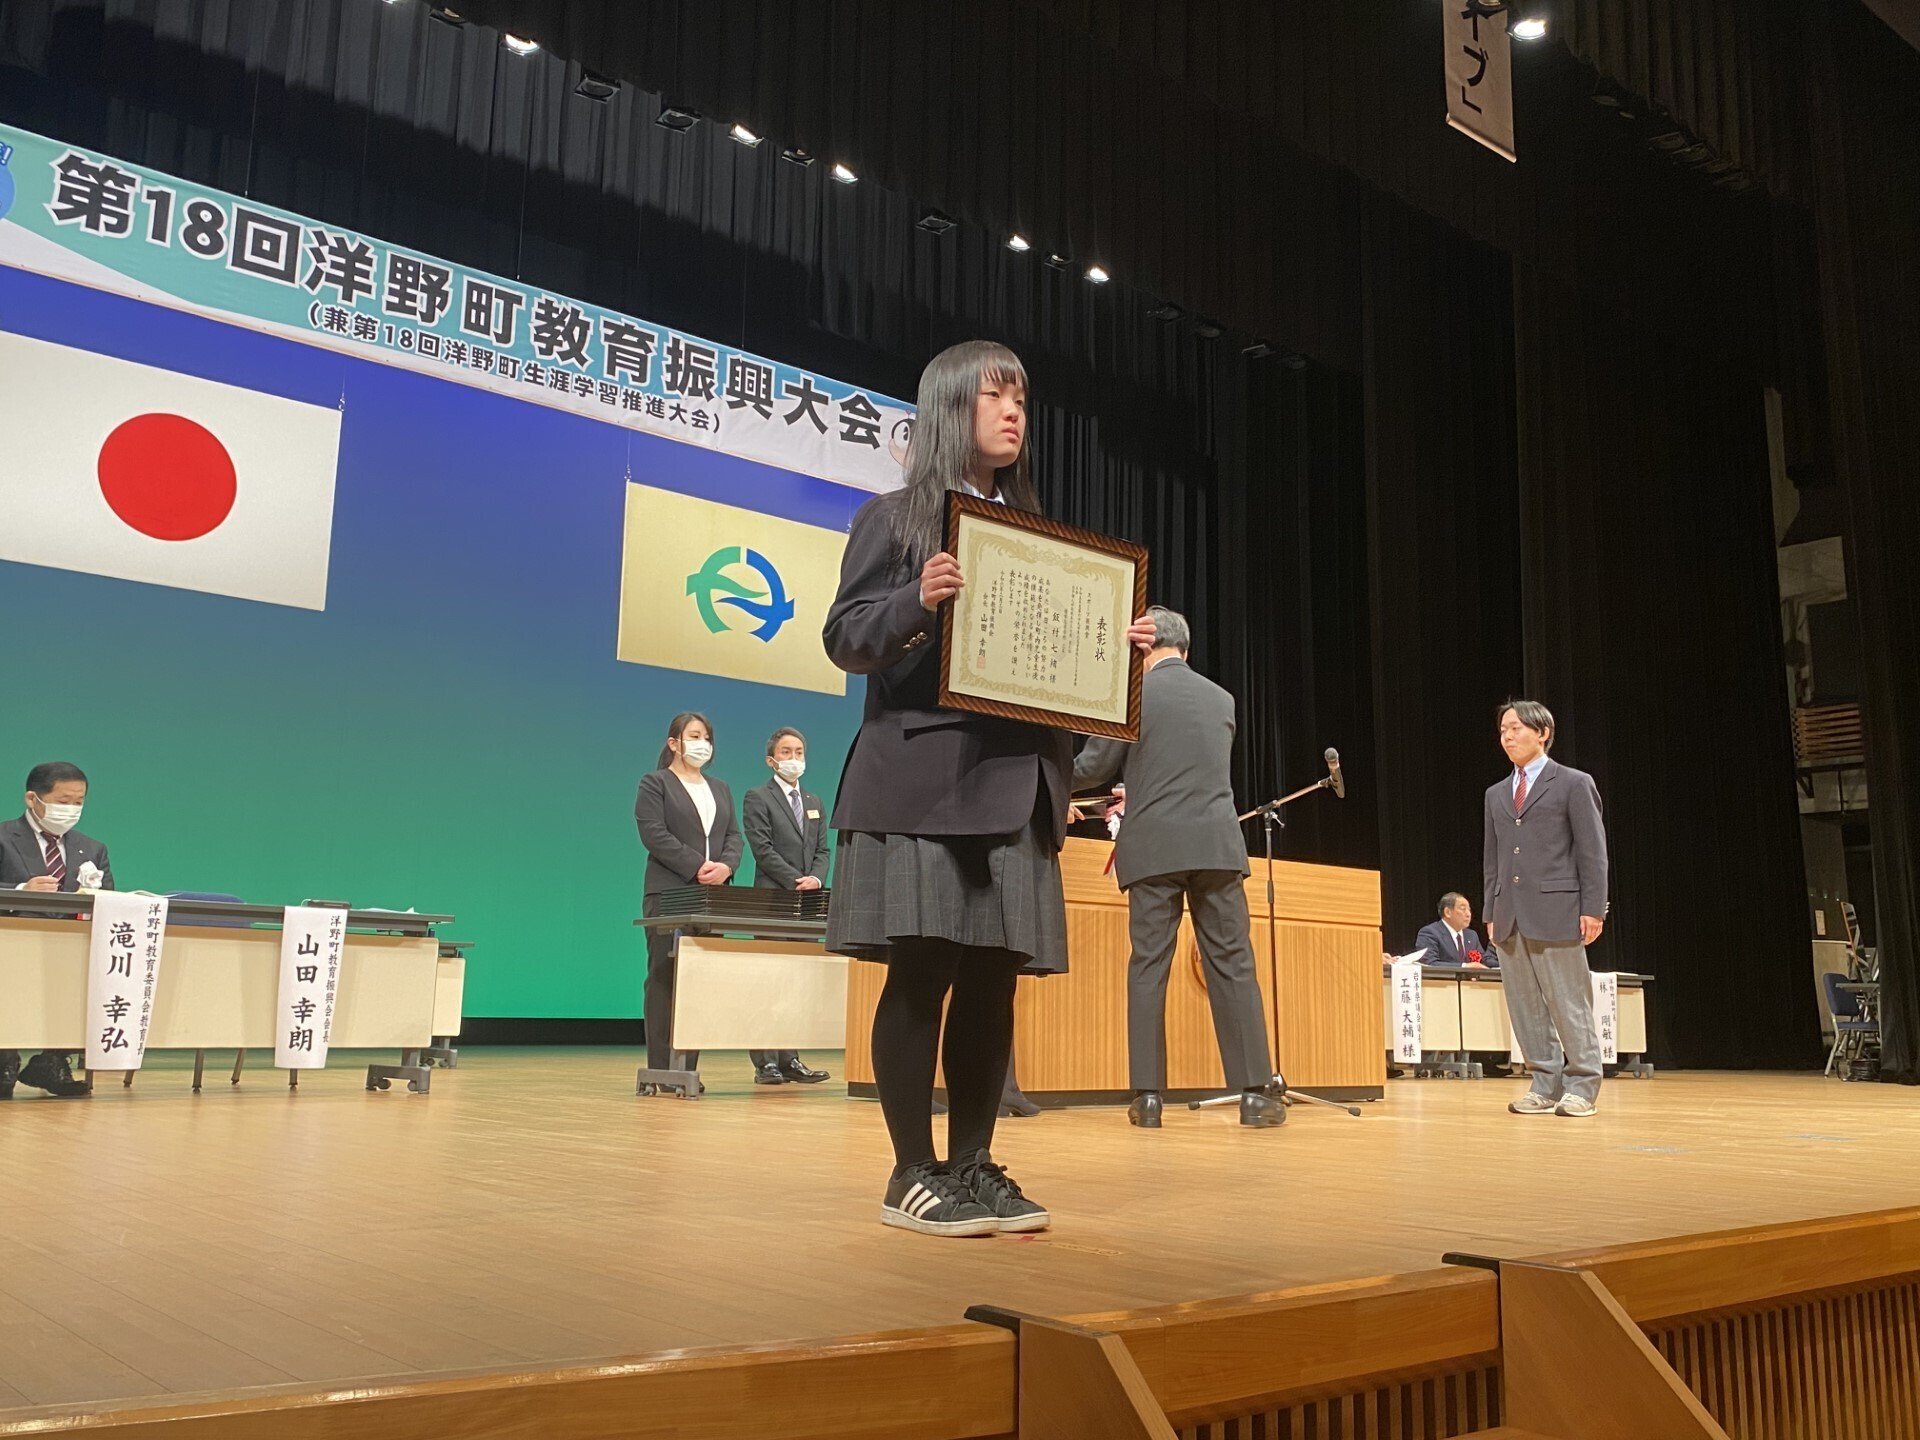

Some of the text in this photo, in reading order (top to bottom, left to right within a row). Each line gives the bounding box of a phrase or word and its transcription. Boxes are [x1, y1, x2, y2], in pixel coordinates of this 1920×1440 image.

[50, 153, 882, 450] 第18回洋野町教育振興大会
[1095, 616, 1107, 662] 表彰状
